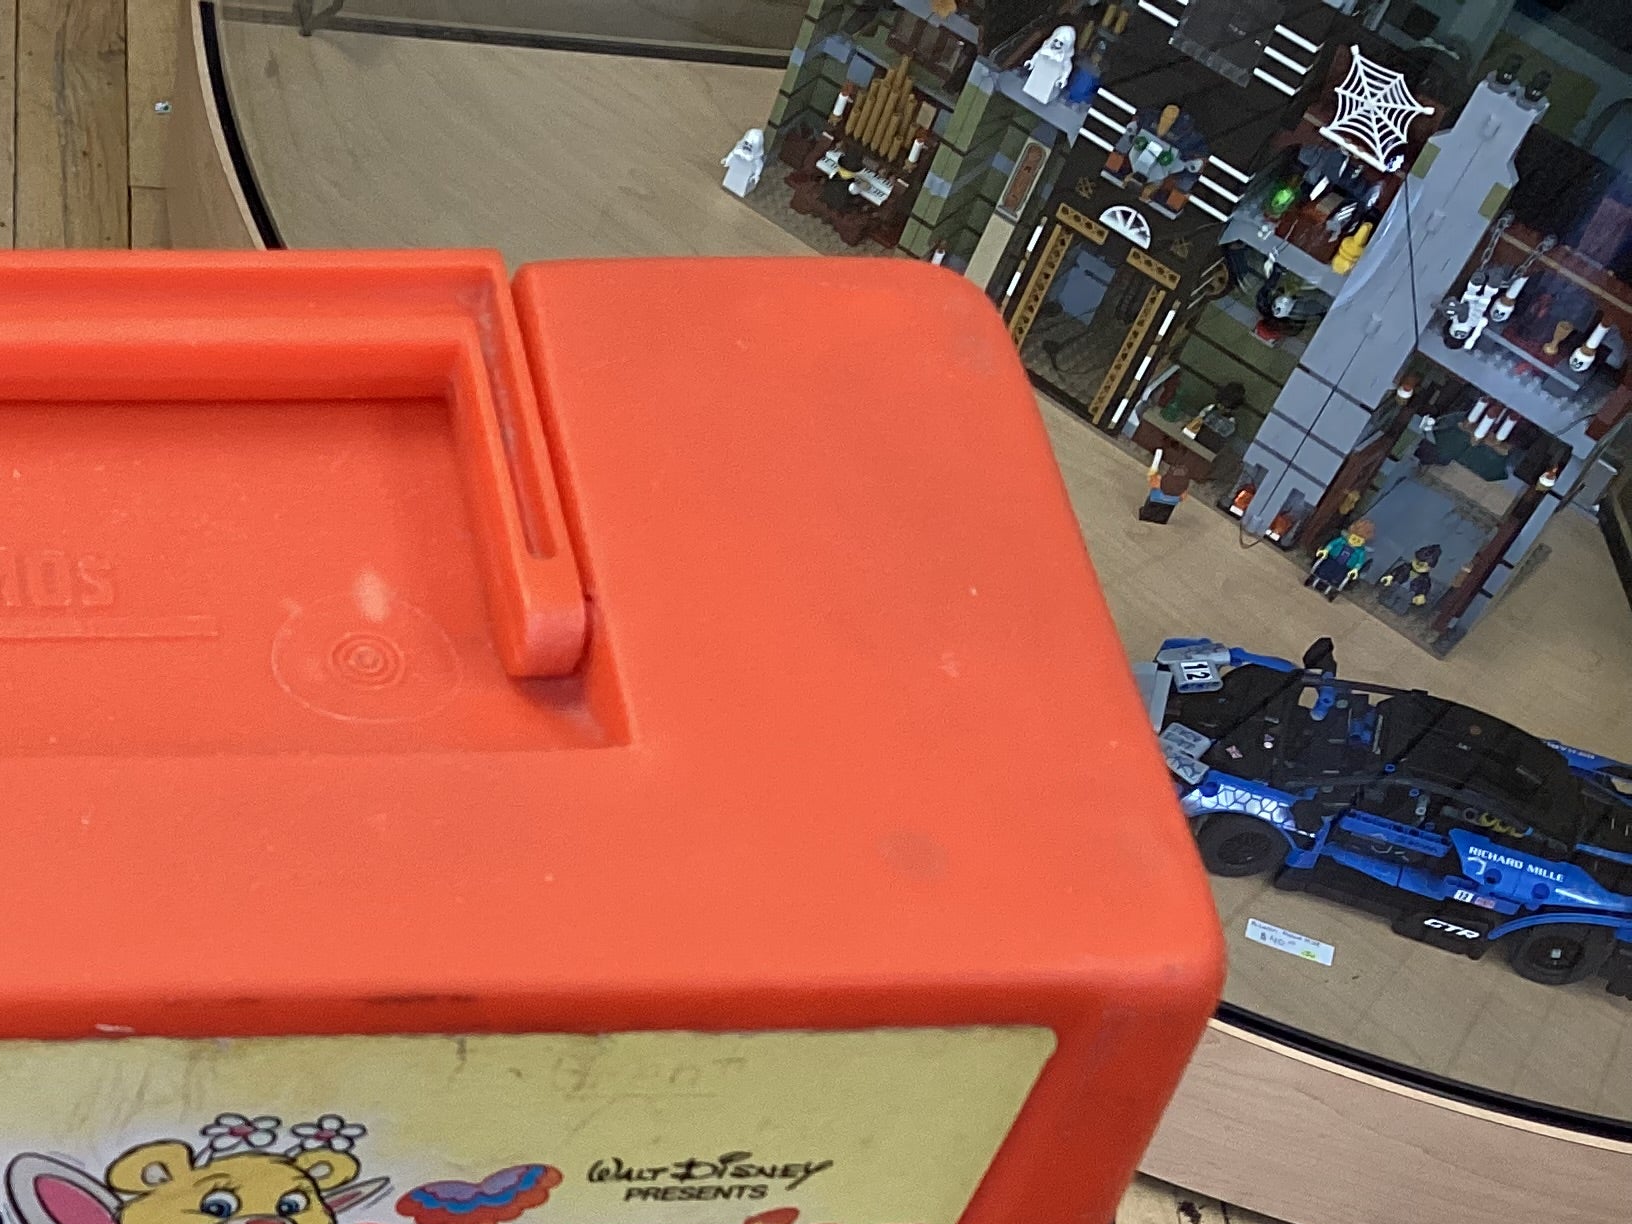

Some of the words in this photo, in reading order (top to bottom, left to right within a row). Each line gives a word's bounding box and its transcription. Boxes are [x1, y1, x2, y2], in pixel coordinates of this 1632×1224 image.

[1184, 663, 1211, 680] 12
[1468, 846, 1524, 870] RICHARD
[1526, 863, 1566, 883] MILLE
[1423, 918, 1480, 939] GTR
[624, 1184, 769, 1202] PRESENTS
